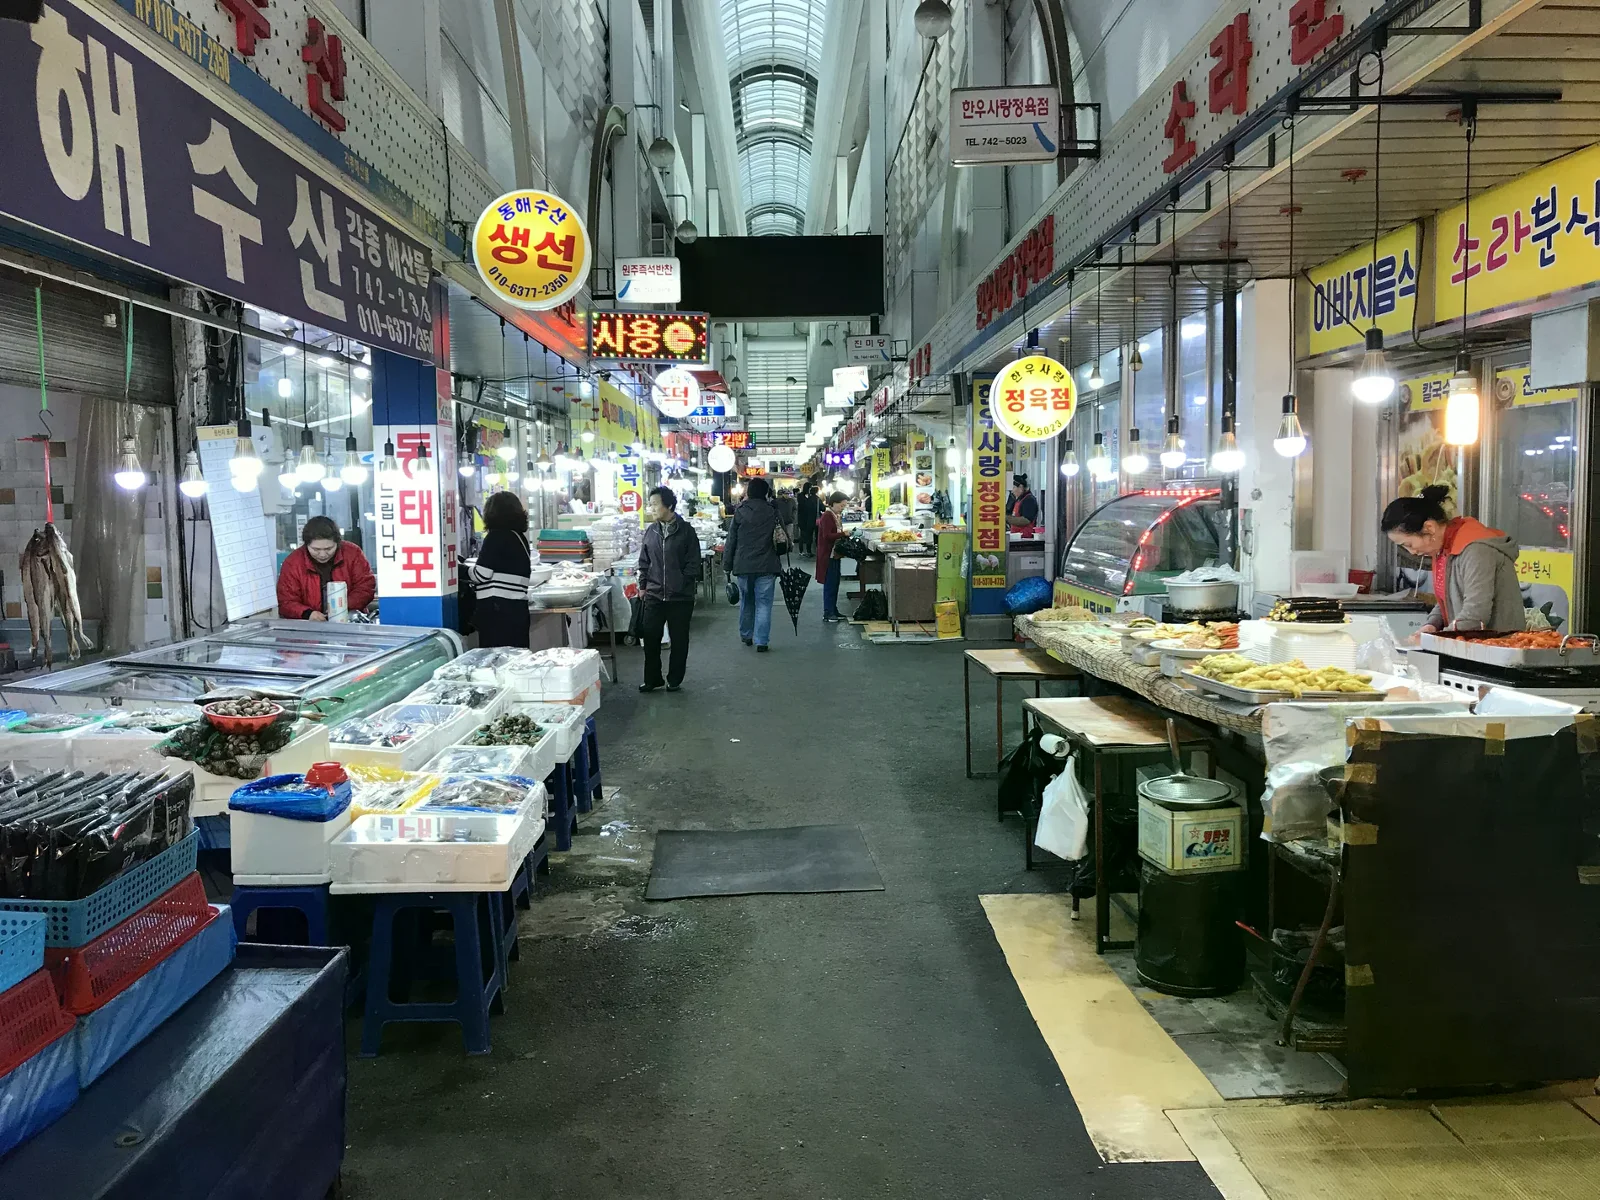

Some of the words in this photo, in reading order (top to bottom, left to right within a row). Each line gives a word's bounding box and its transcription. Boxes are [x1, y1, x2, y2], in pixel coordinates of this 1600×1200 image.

[962, 97, 1049, 119] 한우사랑정육점
[982, 136, 1027, 146] 742-5023
[497, 197, 568, 226] 동해수산
[345, 206, 382, 268] 각종
[384, 231, 431, 289] 해산물
[488, 223, 576, 273] 생선
[488, 266, 568, 298] 010-6377-2350
[622, 264, 673, 276] 원주즉석반찬
[854, 339, 885, 348] 진미당
[1010, 363, 1065, 383] 한우사랑
[1005, 387, 1070, 412] 정육점
[1013, 419, 1062, 435] 742-5023
[977, 384, 1002, 550] 한우사랑정육점
[396, 432, 438, 590] 동태포
